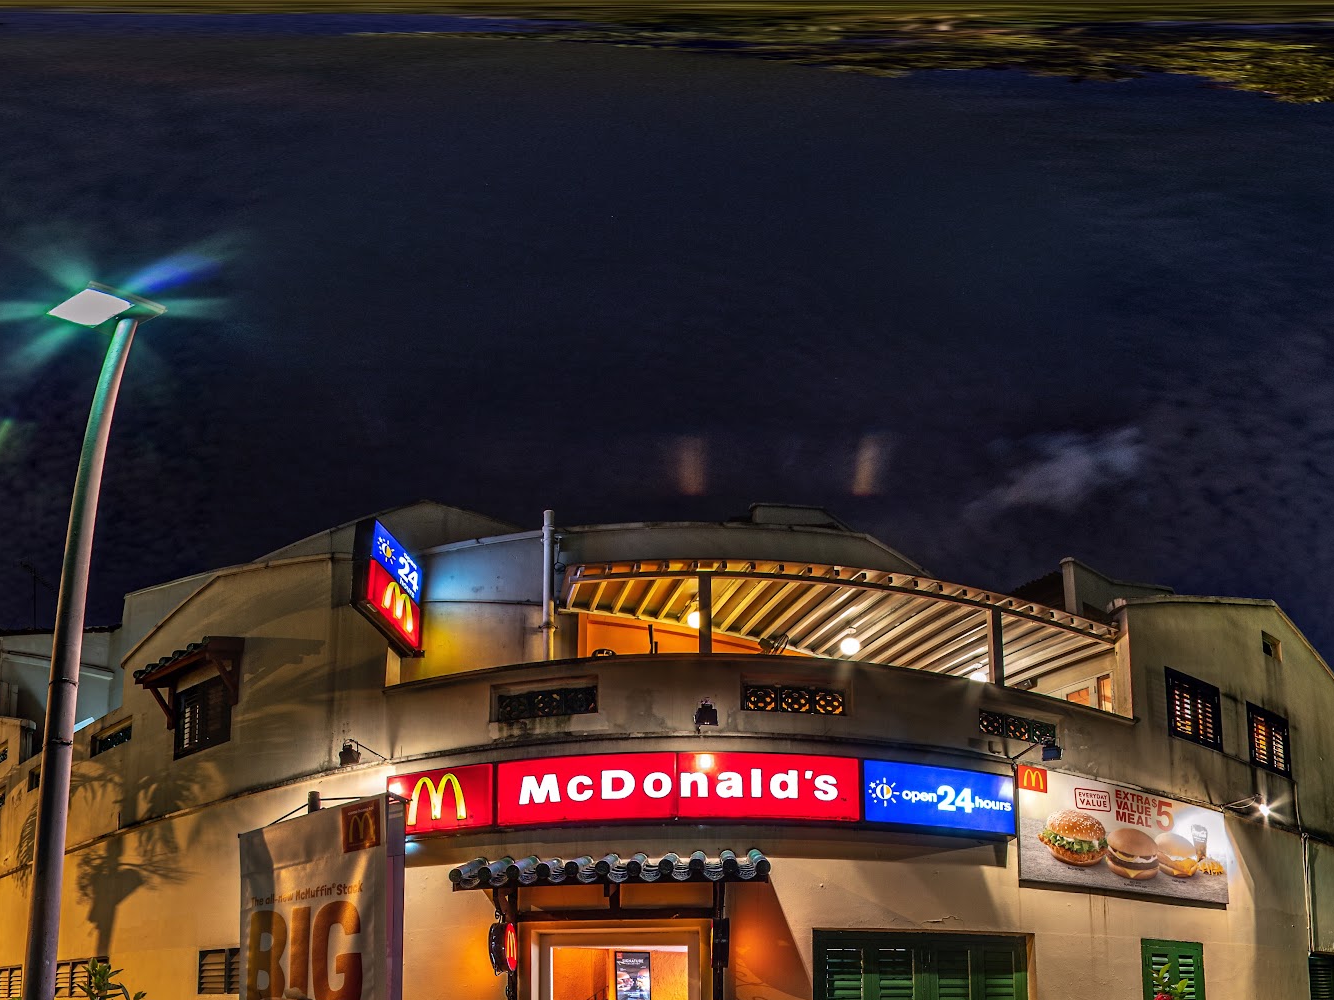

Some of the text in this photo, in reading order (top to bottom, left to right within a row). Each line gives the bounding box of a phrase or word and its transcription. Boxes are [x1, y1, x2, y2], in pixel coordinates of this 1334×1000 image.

[398, 556, 419, 592] 24
[518, 768, 839, 805] McDonald's
[1078, 791, 1107, 800] EVERYDAY
[902, 784, 1012, 813] open 24 hours
[1079, 798, 1108, 808] VALUE
[1115, 789, 1151, 807] EXTRA
[1115, 799, 1152, 816] VALUE
[1115, 810, 1152, 828] MEAL
[251, 896, 263, 907] The
[336, 880, 364, 896] Stack
